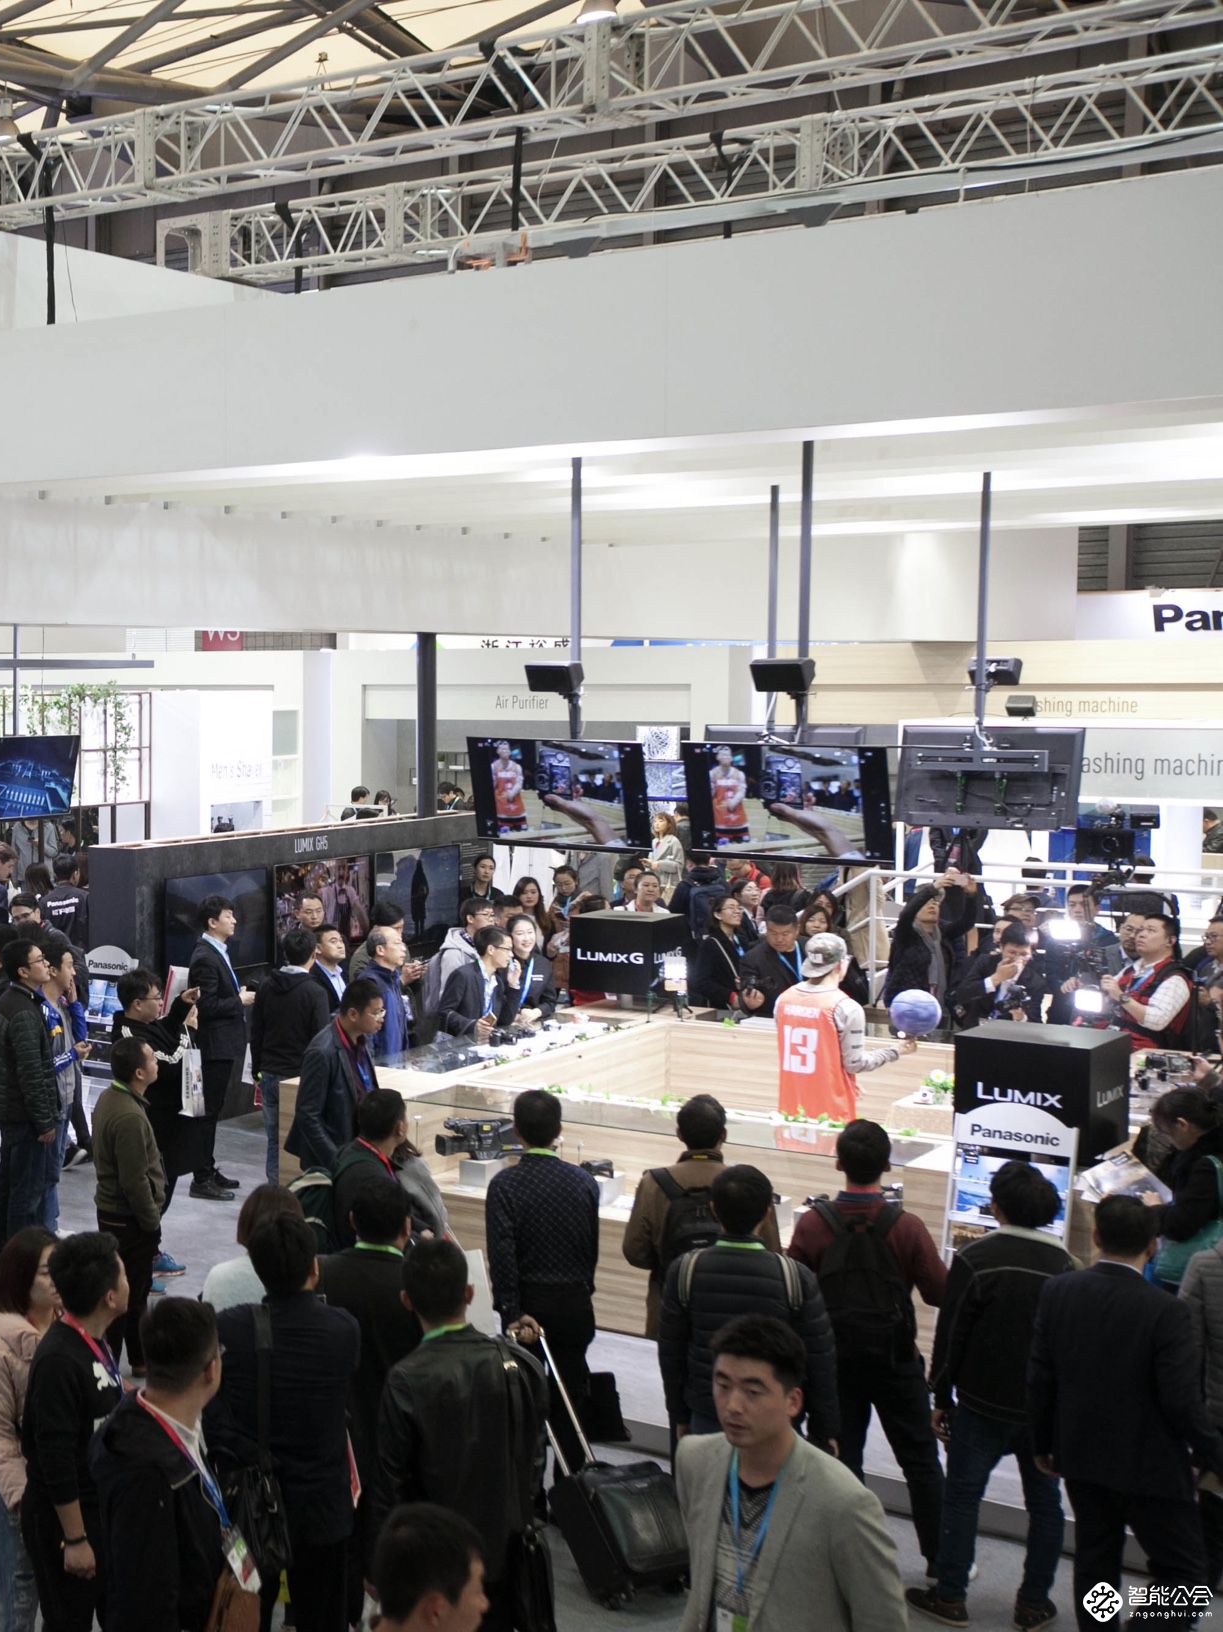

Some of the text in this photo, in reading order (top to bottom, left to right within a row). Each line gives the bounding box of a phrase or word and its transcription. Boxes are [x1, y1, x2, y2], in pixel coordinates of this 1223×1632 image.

[495, 695, 549, 709] Air Purifier
[1036, 697, 1138, 717] shing machine
[1081, 752, 1145, 781] ashing
[294, 836, 314, 854] LUMIX
[88, 959, 128, 971] Panasonic
[782, 1024, 819, 1075] 13
[976, 1081, 1063, 1109] LUMIX
[1096, 1085, 1124, 1108] LUMIX
[970, 1123, 1061, 1147] Panasonic
